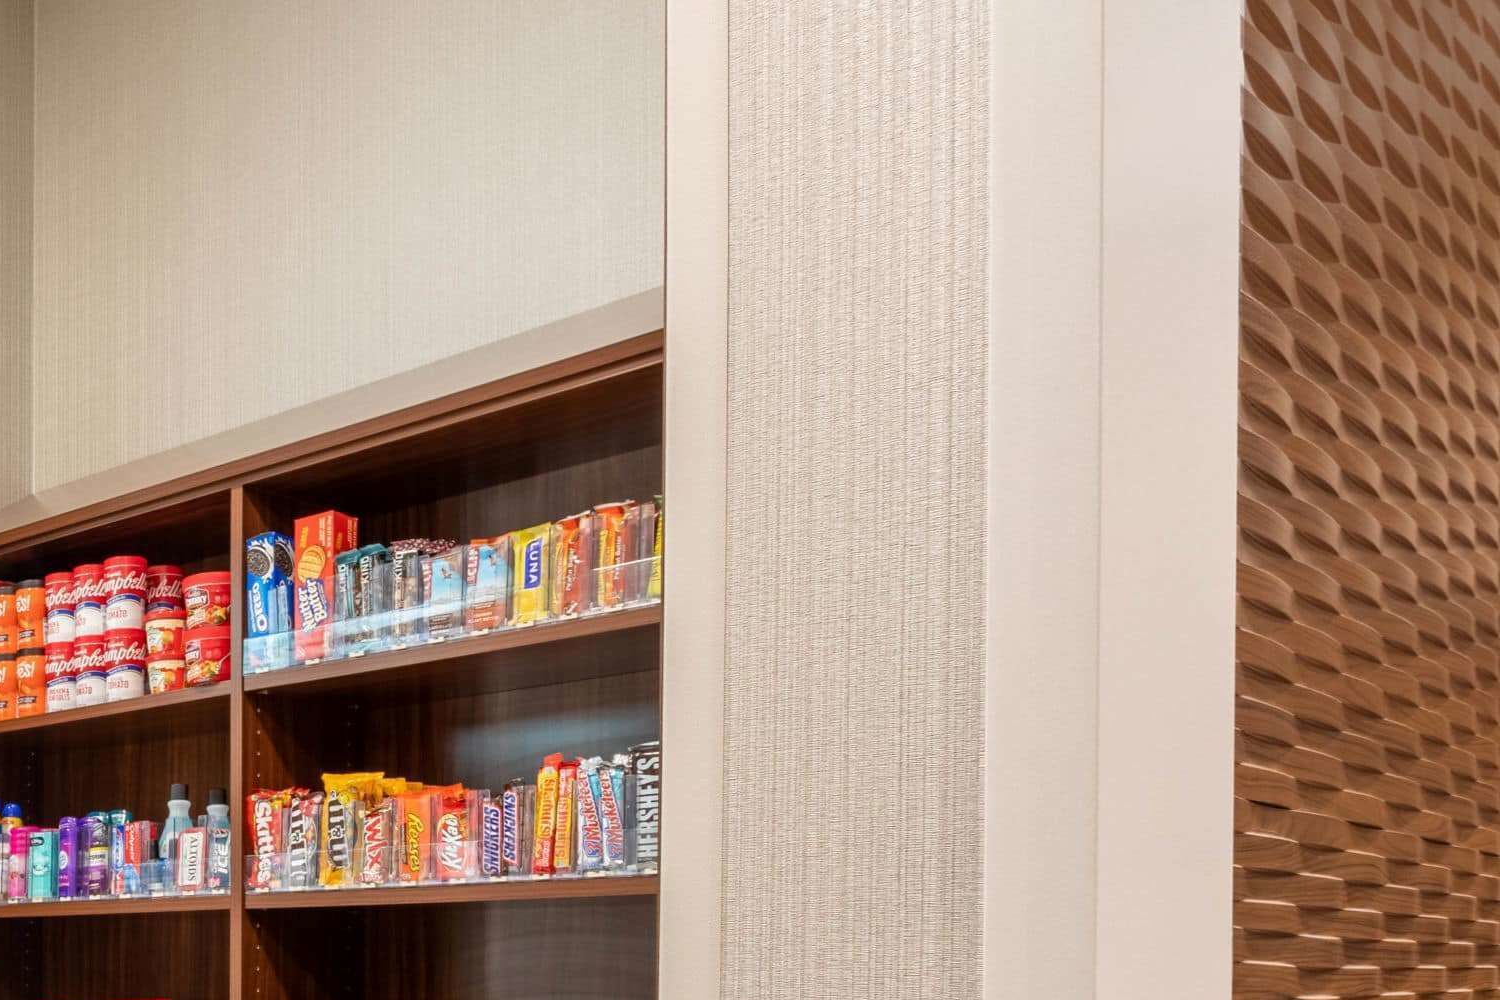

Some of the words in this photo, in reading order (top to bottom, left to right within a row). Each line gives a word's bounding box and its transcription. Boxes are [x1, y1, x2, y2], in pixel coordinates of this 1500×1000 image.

[529, 540, 540, 584] LUNA
[252, 582, 268, 632] OREO
[298, 587, 318, 633] Nutter
[307, 579, 328, 621] Butter
[188, 836, 198, 882] ALTOIDS
[254, 800, 275, 883] Skittles
[484, 806, 500, 874] SNICKERS
